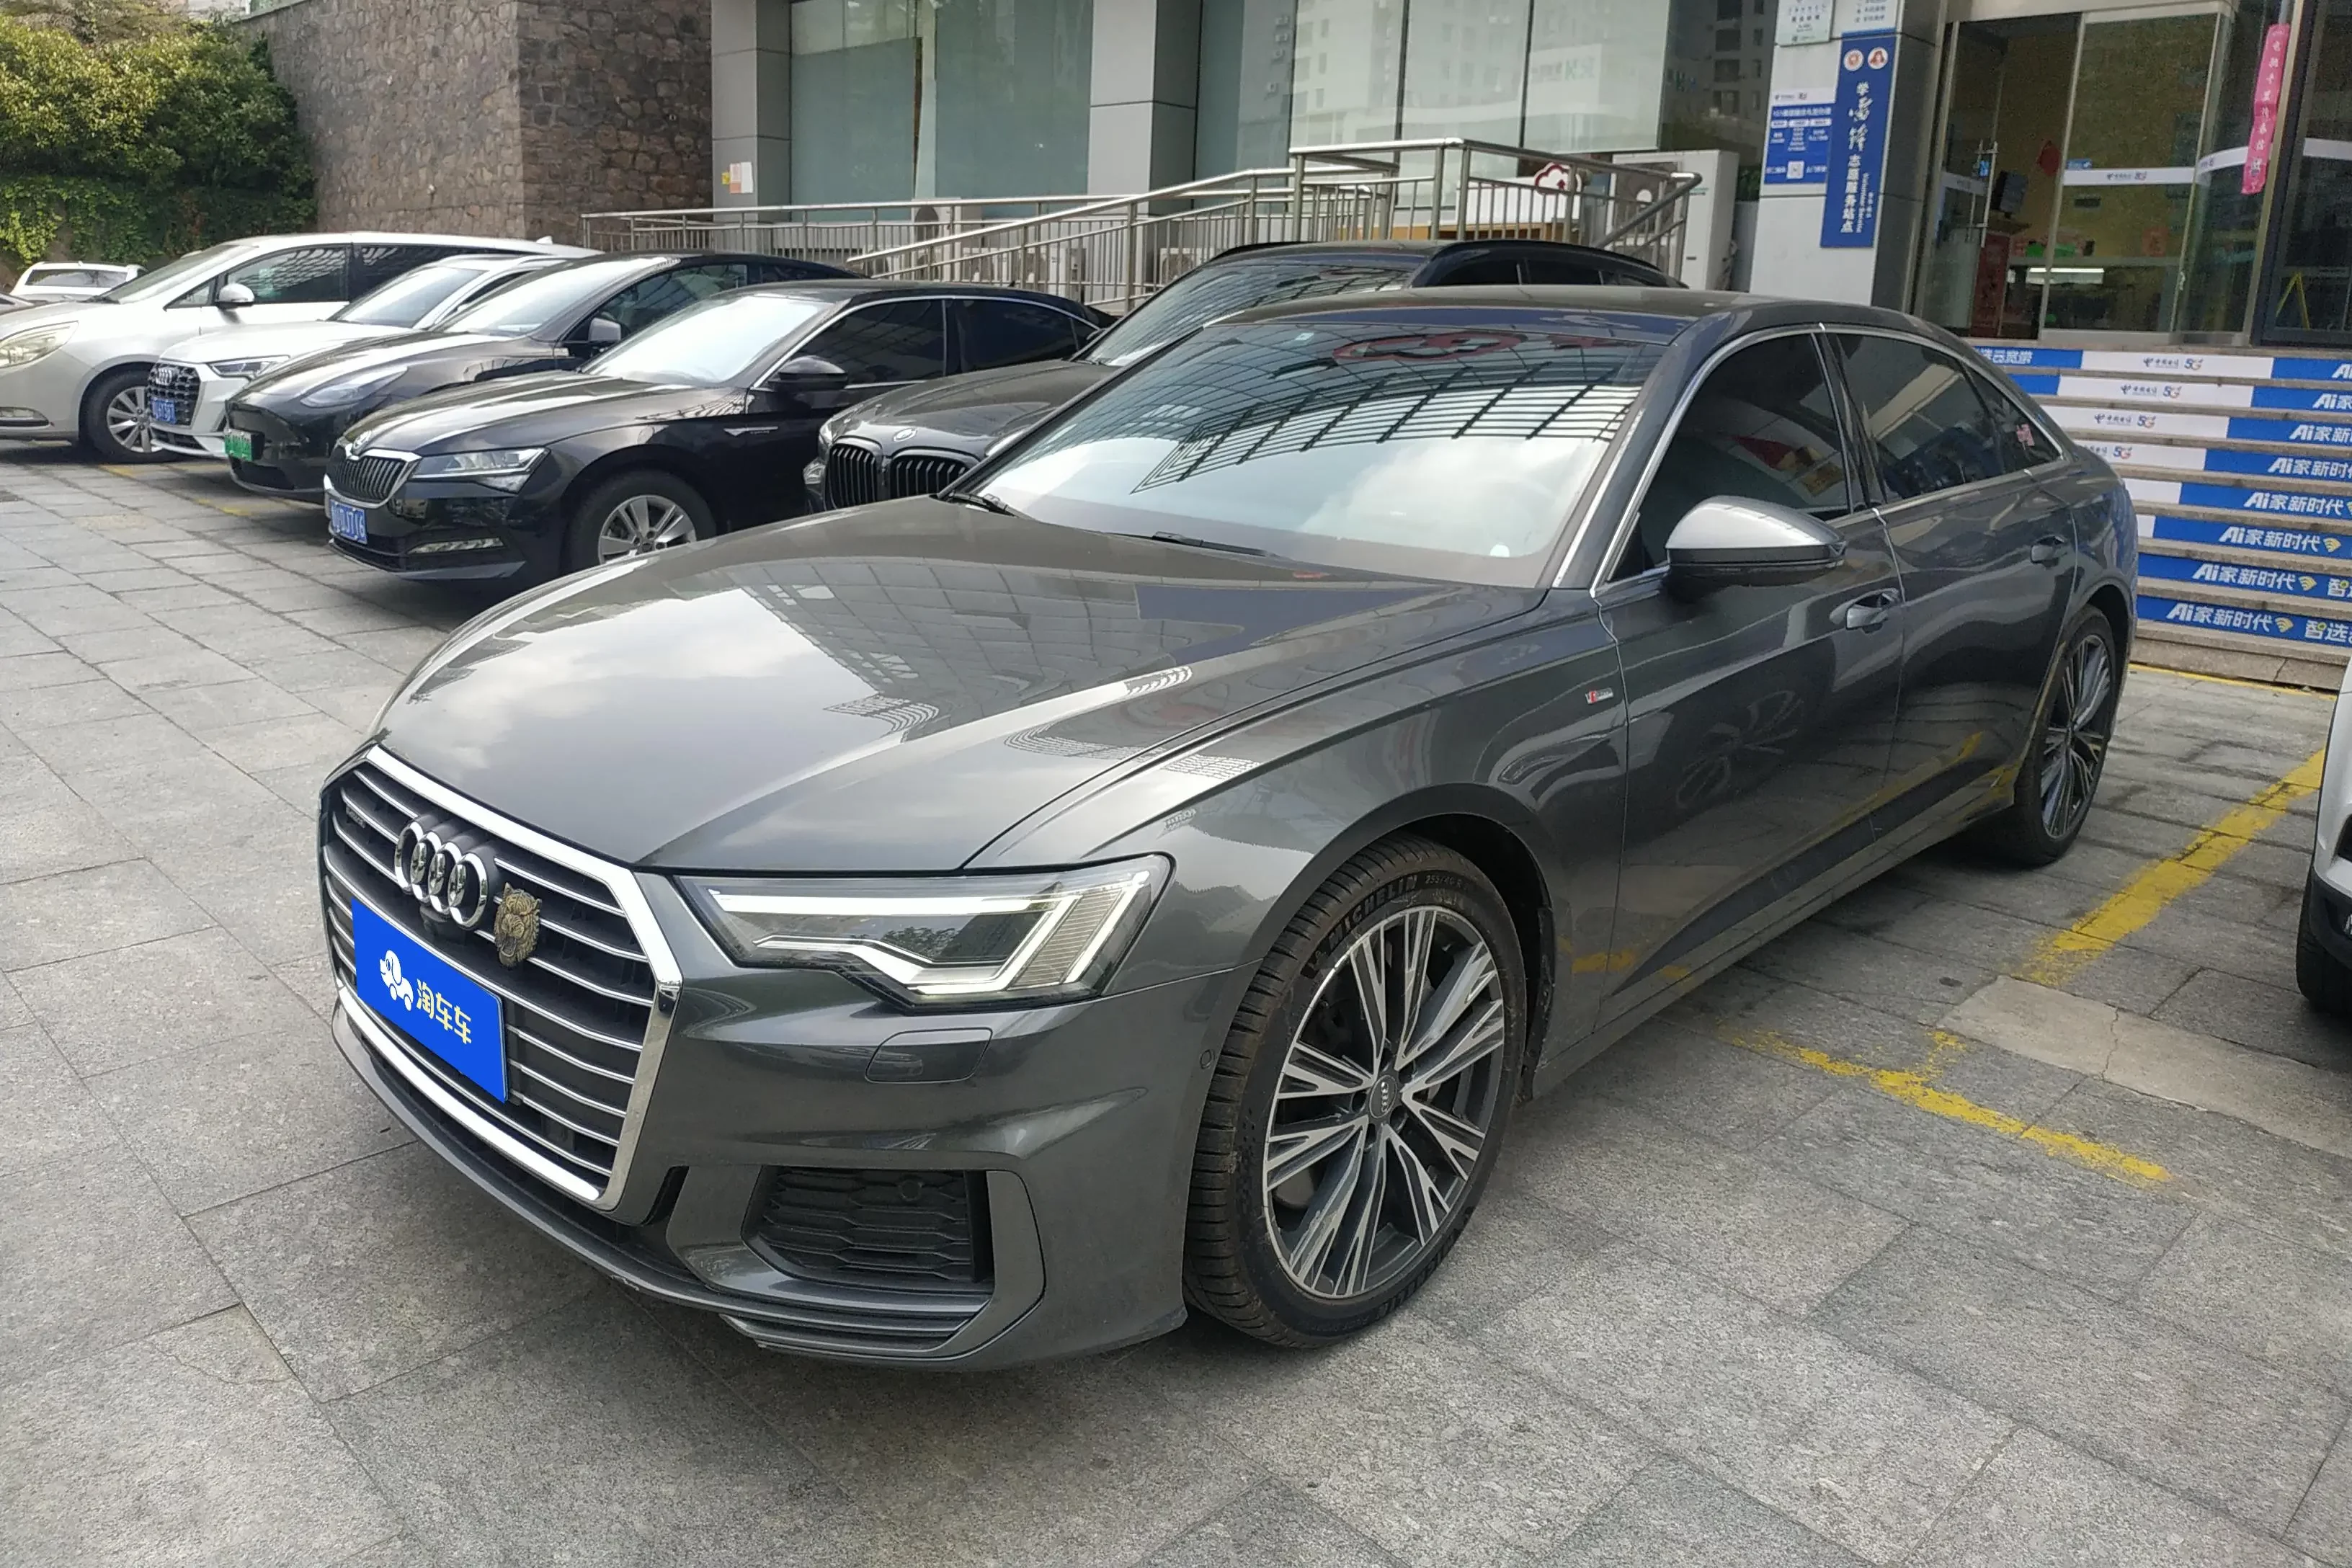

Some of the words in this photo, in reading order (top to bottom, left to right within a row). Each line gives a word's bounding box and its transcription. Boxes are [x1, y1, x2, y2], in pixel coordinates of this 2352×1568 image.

[2332, 363, 2352, 379] A
[2289, 424, 2352, 444] Ai家新
[2268, 457, 2352, 479] Ai家新时
[2244, 491, 2344, 516] Ai家新时代
[2219, 526, 2321, 553] Ai家新时代
[2192, 564, 2296, 591] Ai家新时代
[2327, 578, 2352, 598] 智
[2166, 602, 2273, 633] Ai家新时代
[2304, 620, 2352, 643] 智选
[1328, 876, 1418, 950] MICHELIN
